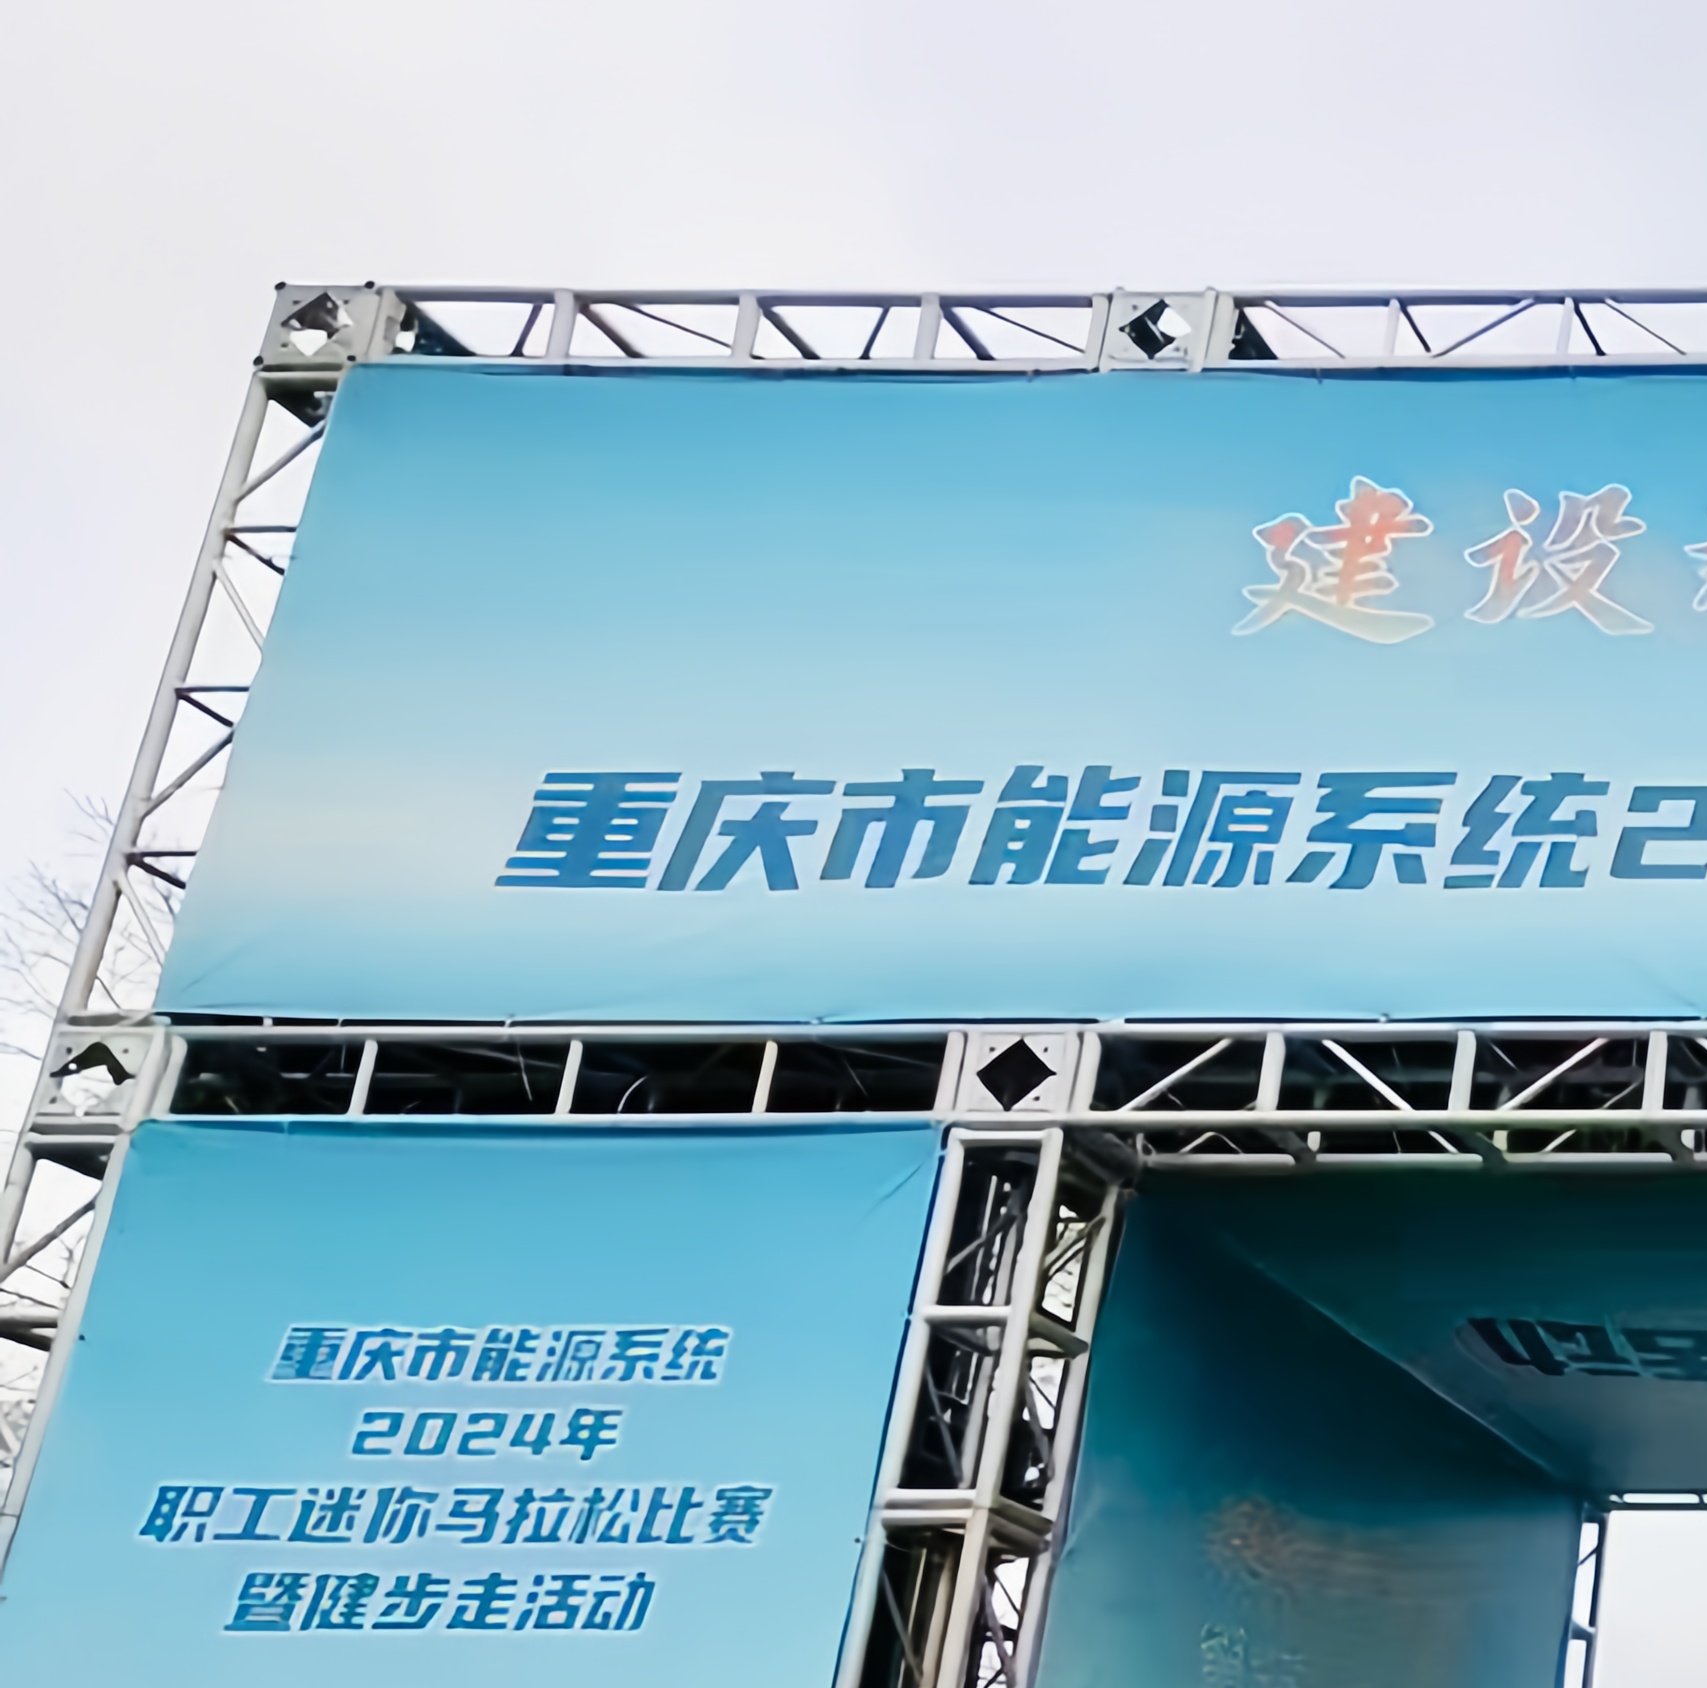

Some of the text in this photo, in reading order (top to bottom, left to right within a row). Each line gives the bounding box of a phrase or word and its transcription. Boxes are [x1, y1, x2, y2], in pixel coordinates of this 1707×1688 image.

[269, 1325, 733, 1383] 重庆市能源系统
[350, 1409, 623, 1461] 2024年
[139, 1484, 773, 1545] 职工迷你马拉松比赛
[224, 1572, 655, 1632] 暨健步走活动
